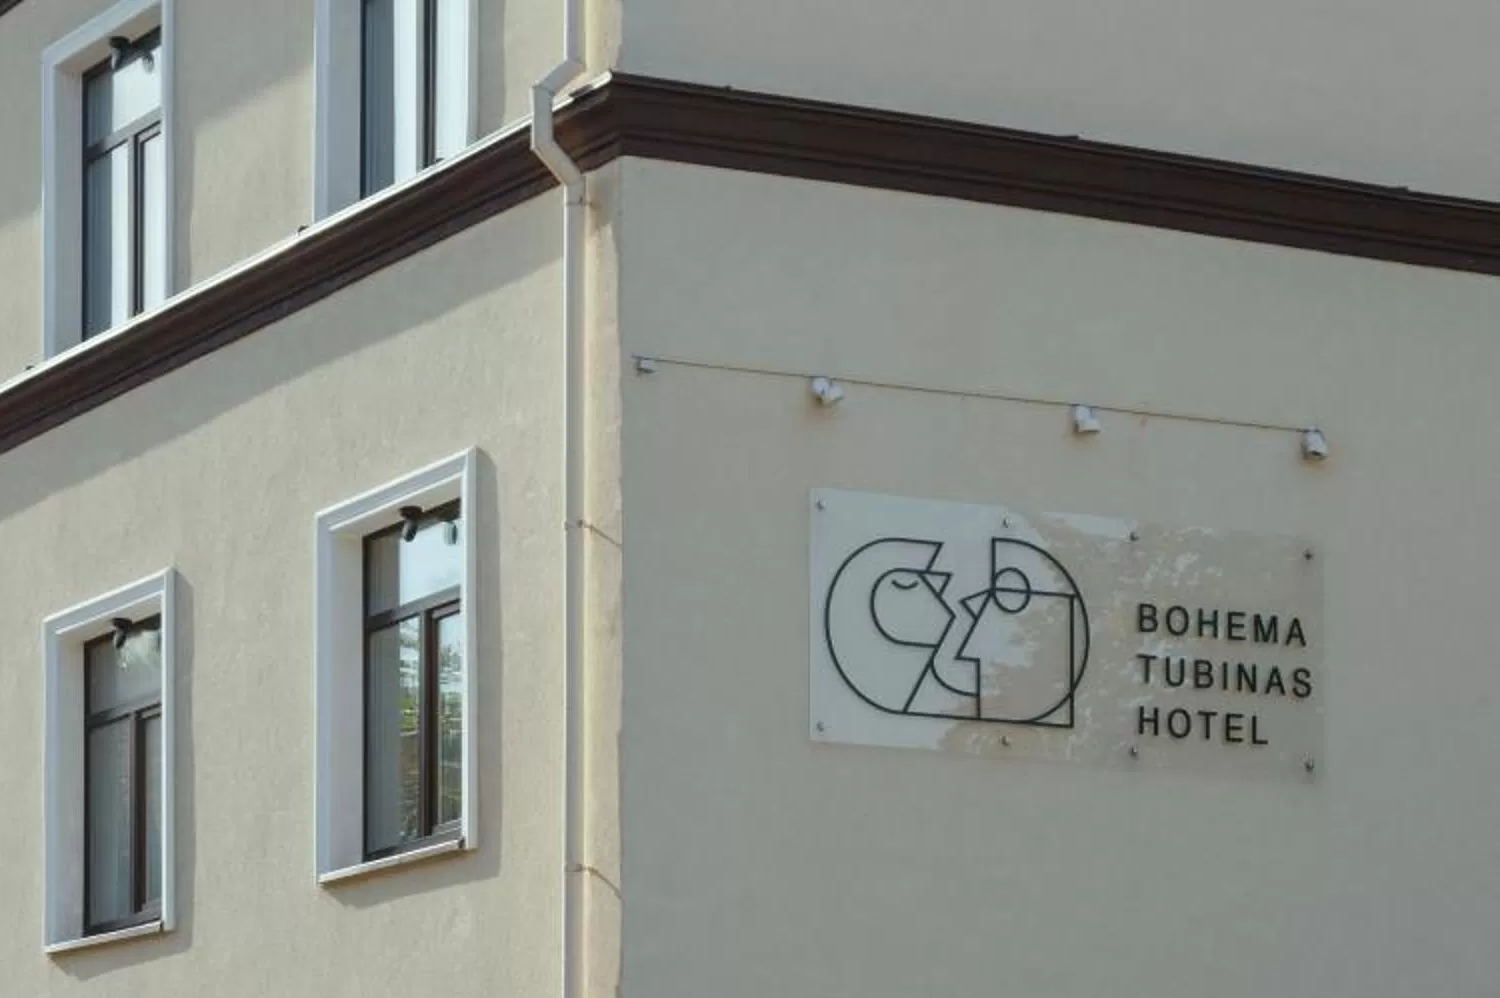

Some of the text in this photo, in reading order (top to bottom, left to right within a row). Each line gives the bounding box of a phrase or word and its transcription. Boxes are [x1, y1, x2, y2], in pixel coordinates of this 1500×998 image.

[1138, 603, 1307, 647] BOHEMA
[1136, 653, 1312, 698] TUBINAS
[1138, 705, 1269, 745] HOTEL
